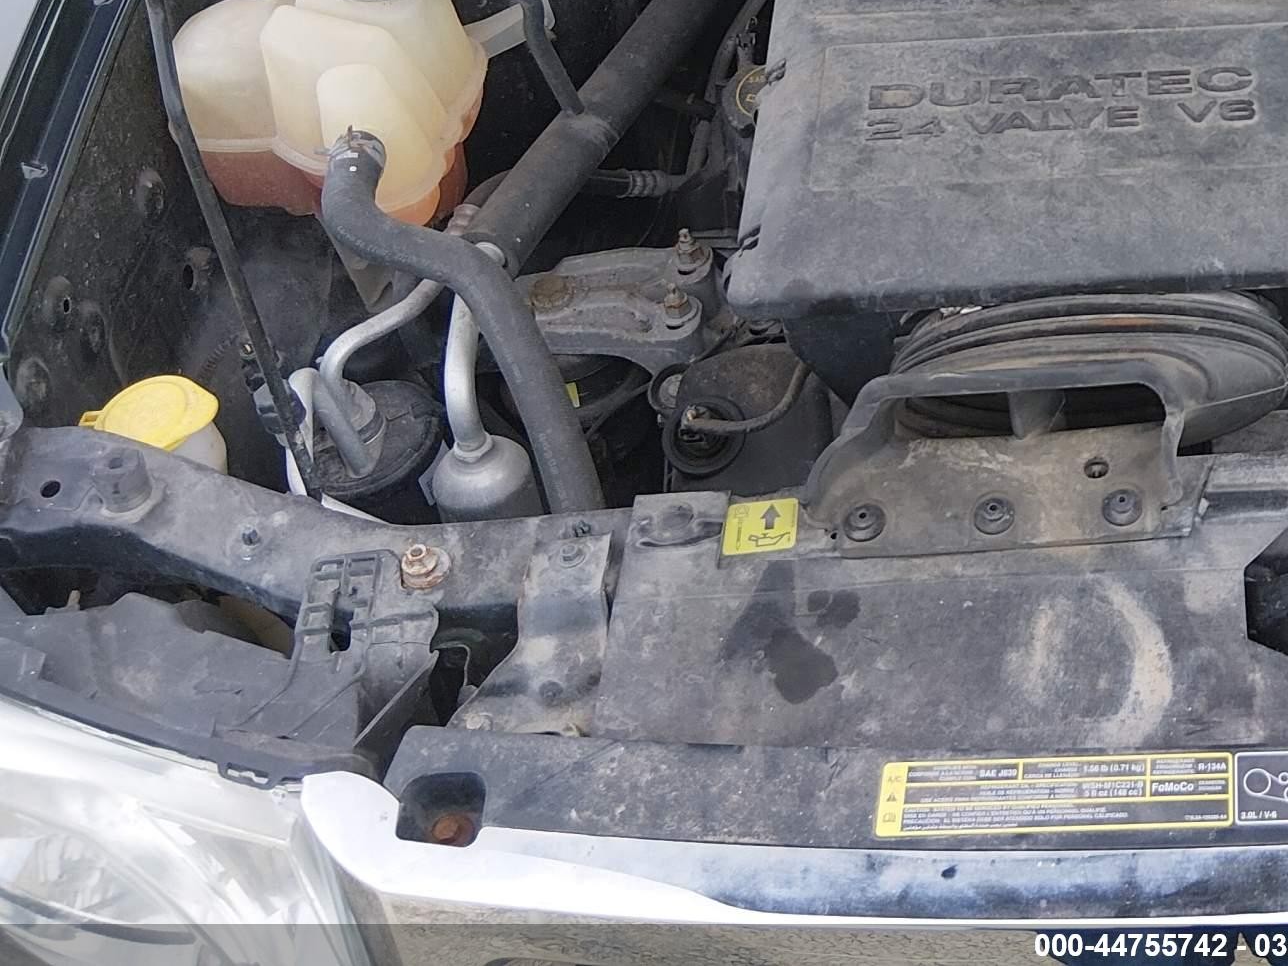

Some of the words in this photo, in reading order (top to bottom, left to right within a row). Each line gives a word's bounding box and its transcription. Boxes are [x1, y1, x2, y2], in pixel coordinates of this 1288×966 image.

[867, 66, 1255, 111] DURATEC
[865, 117, 945, 142] 24
[963, 106, 1140, 135] VALVE
[1176, 98, 1258, 124] V6
[1198, 762, 1226, 771] R-134A
[1152, 781, 1194, 793] FoMoCo
